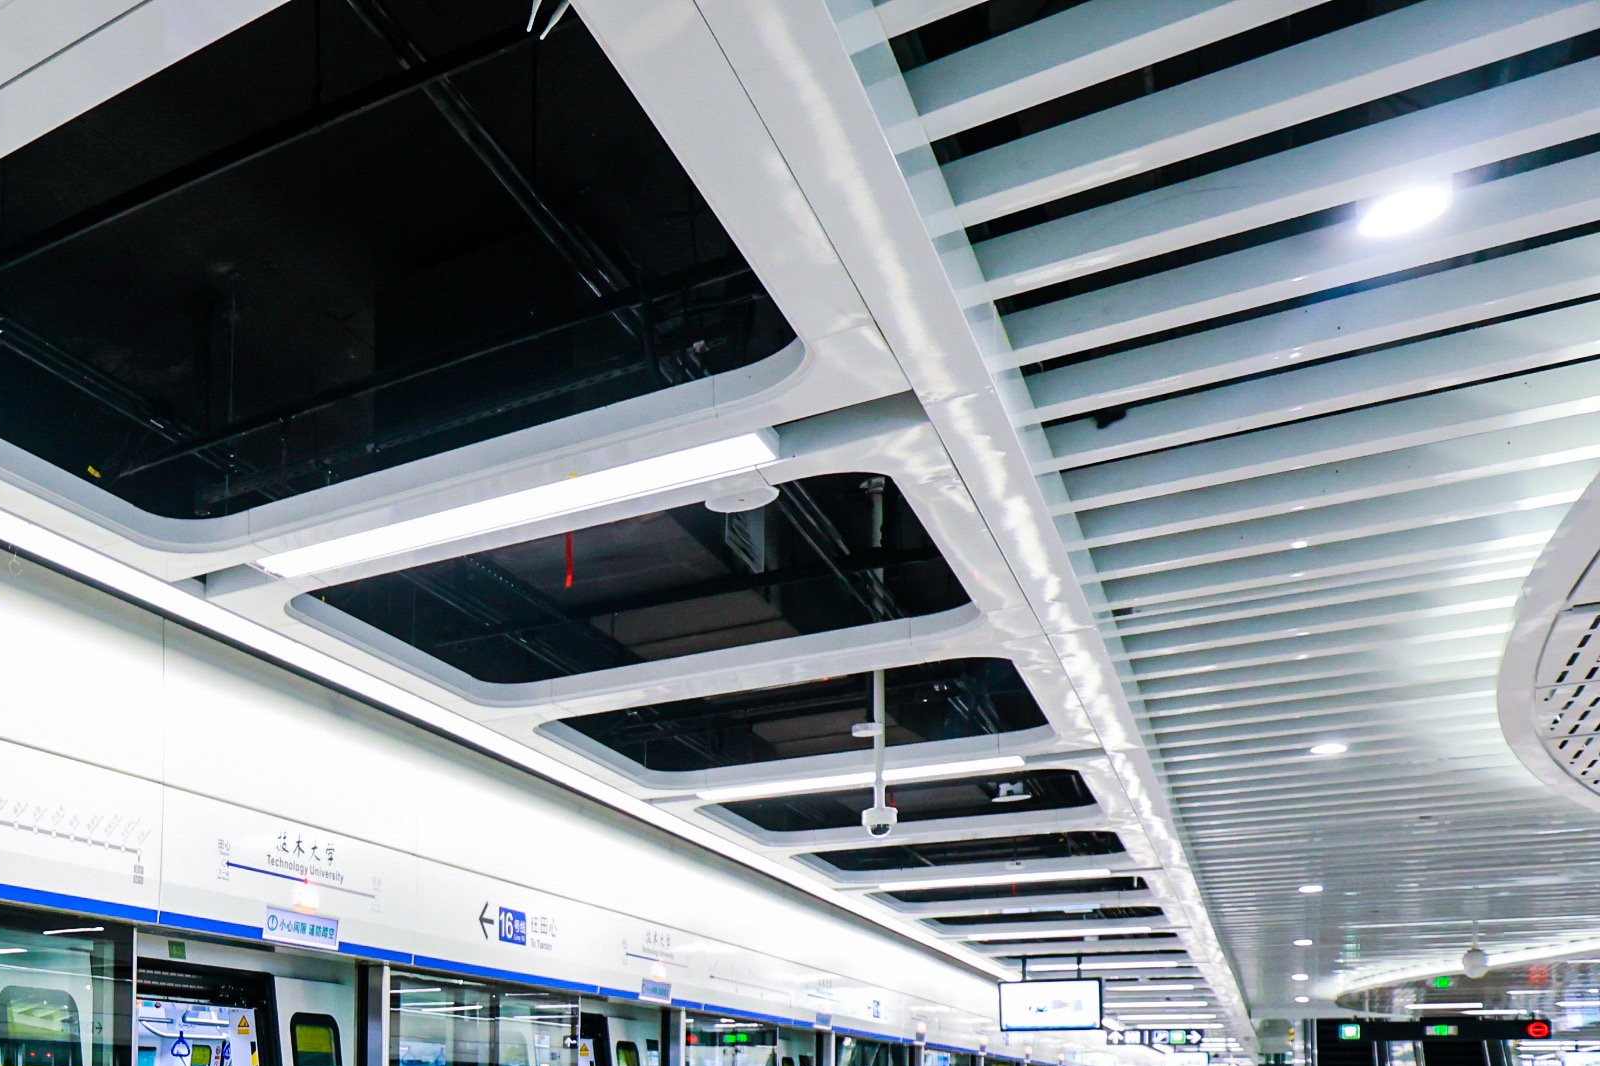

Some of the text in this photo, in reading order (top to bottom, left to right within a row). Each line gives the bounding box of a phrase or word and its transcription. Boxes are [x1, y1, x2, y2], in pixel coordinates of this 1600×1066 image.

[276, 831, 335, 866] 技术大学
[267, 854, 344, 884] Technology University
